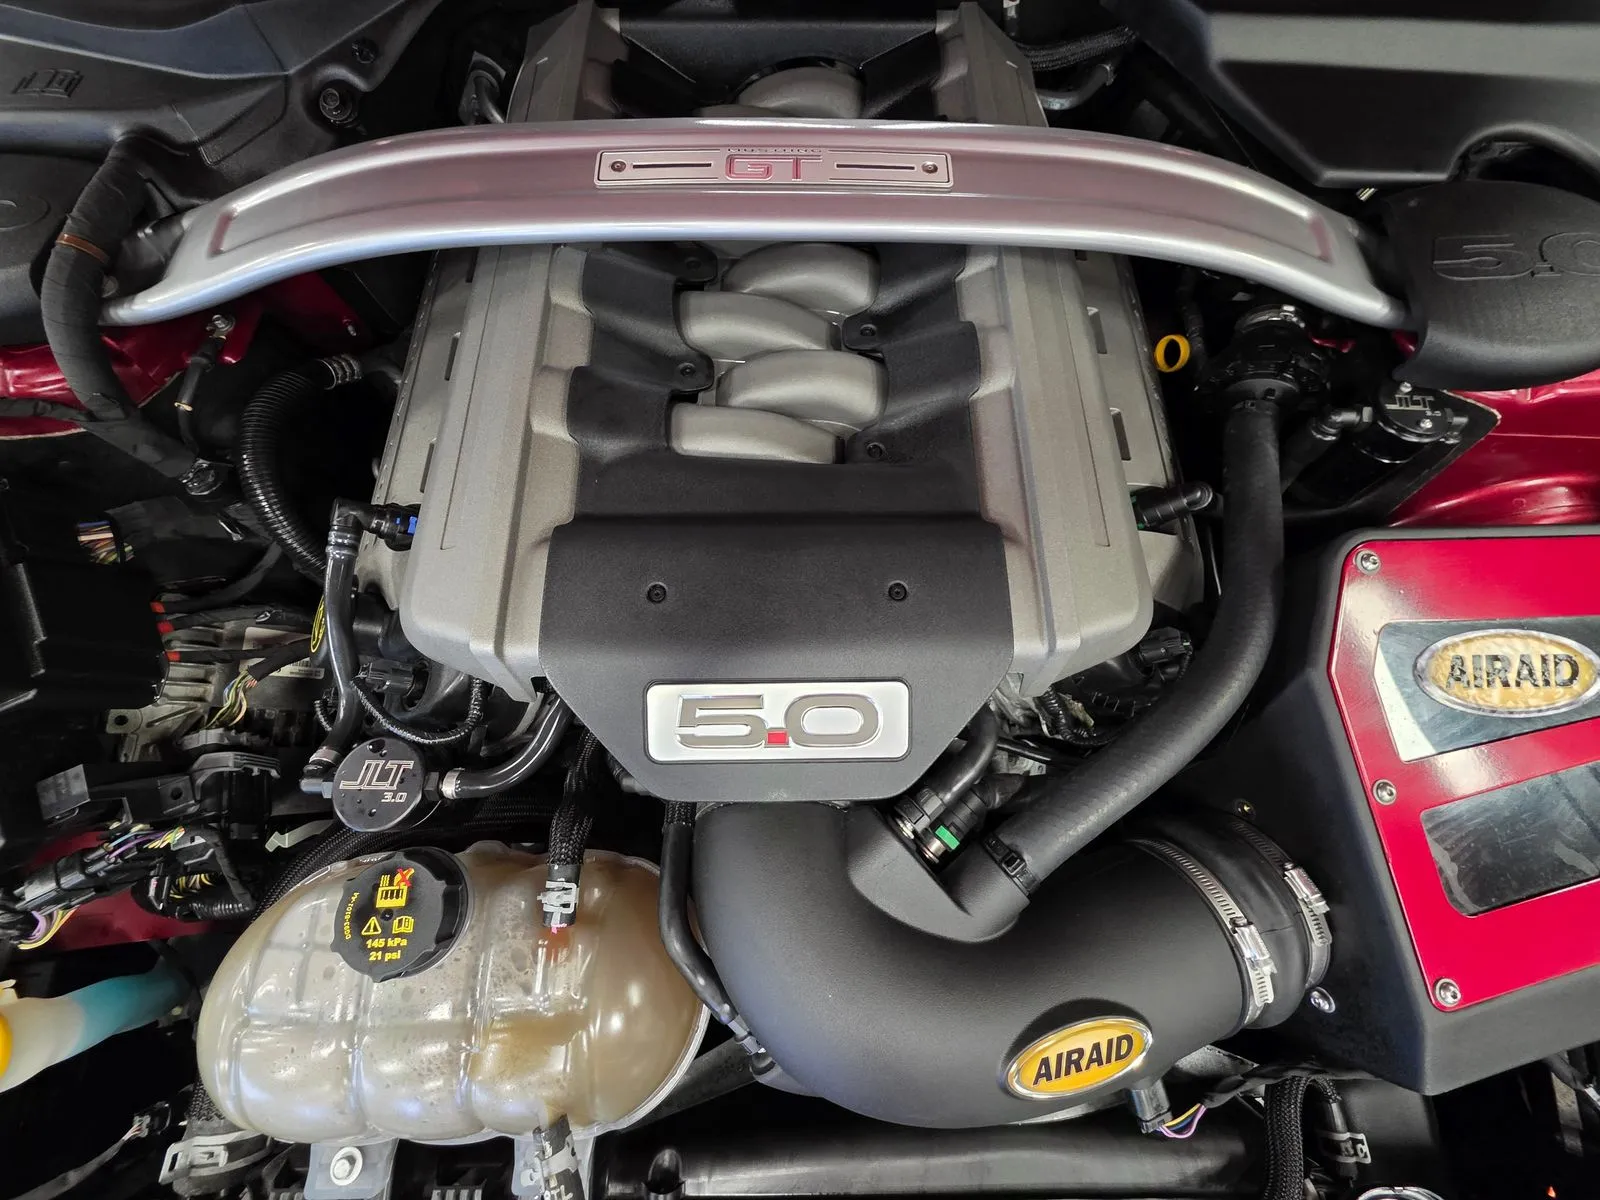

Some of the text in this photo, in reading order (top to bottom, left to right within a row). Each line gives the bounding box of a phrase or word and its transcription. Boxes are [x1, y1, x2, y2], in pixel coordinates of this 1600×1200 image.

[725, 154, 822, 181] GT
[1446, 653, 1580, 689] AIRAID
[677, 693, 883, 749] 5.0
[339, 759, 415, 790] JLT
[381, 791, 408, 803] 3.0
[366, 937, 408, 949] 145 kPa
[369, 949, 401, 962] 21 psi
[1032, 1033, 1134, 1086] AIRAID
